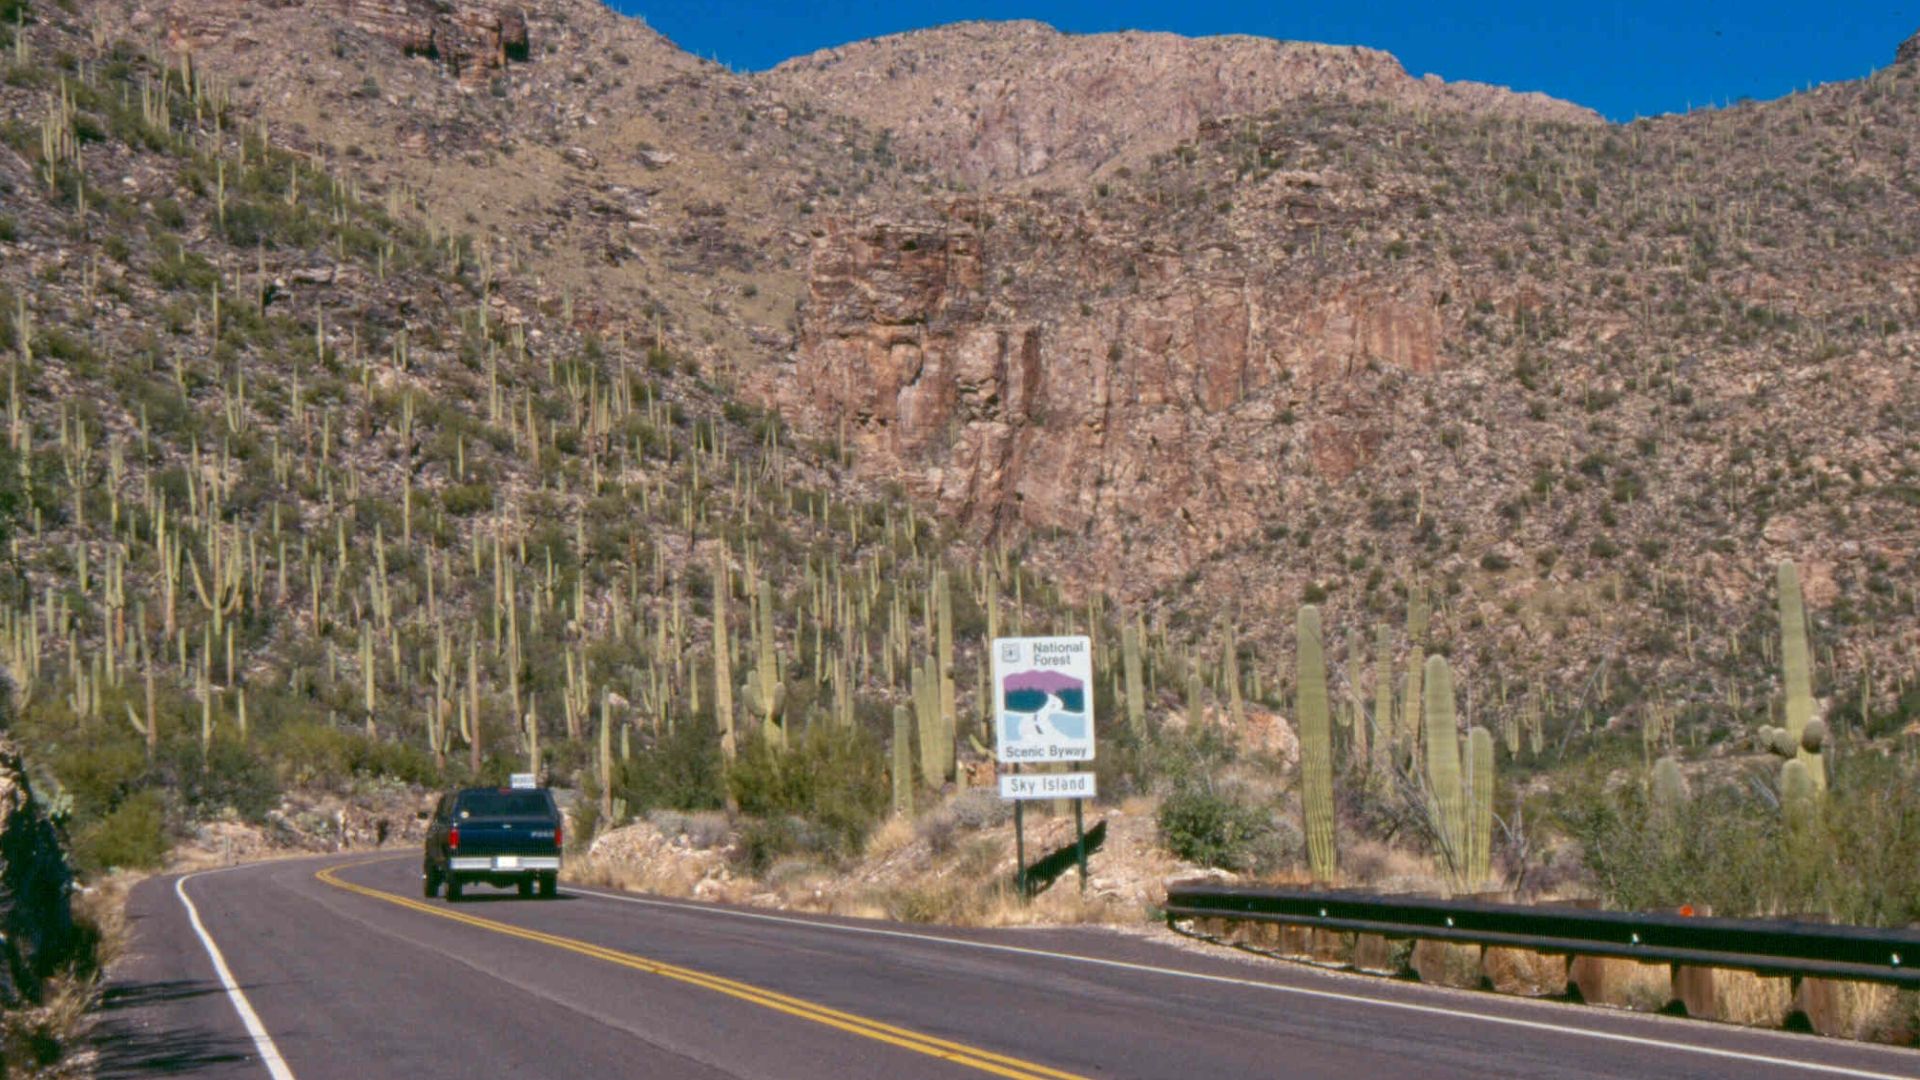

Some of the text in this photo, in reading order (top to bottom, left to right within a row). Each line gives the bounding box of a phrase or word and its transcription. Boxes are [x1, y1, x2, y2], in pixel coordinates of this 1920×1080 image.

[1033, 641, 1083, 653] National
[1034, 655, 1071, 666] Forest
[1006, 744, 1087, 758] Scenic Byway
[1011, 777, 1085, 794] Sky Island
